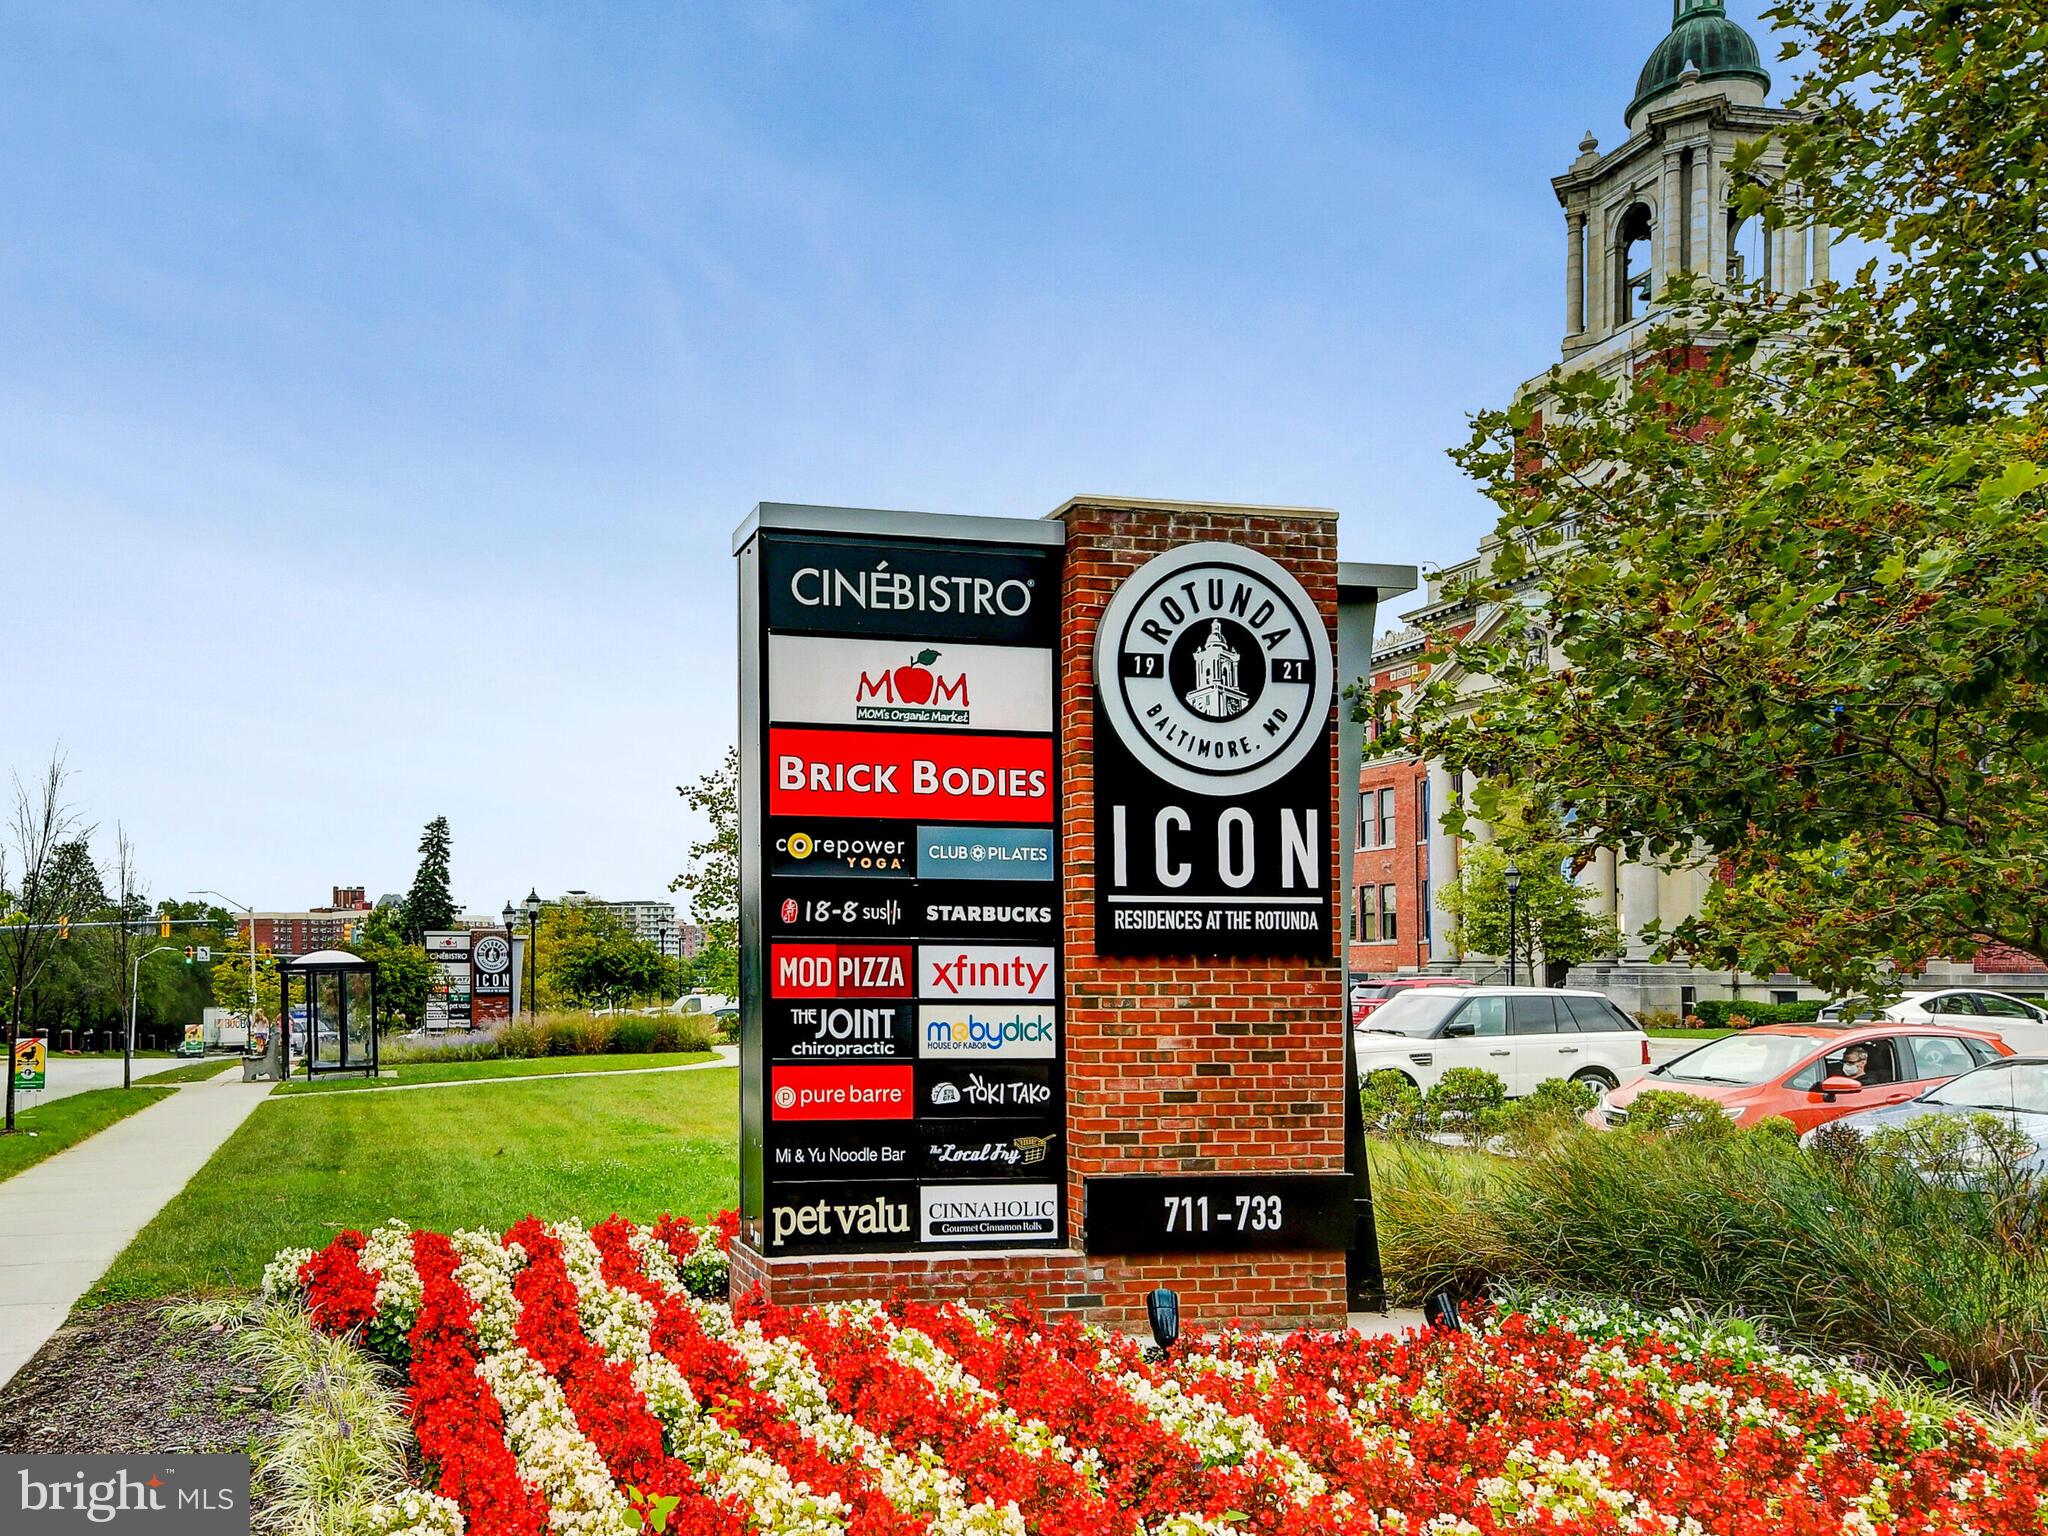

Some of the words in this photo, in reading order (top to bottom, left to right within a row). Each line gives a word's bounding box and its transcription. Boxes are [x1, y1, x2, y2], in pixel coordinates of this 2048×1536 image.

[1141, 578, 1292, 651] ROTUNDA
[1134, 656, 1155, 675] 19
[1283, 662, 1303, 680] 21
[857, 708, 890, 720] MOM's
[891, 710, 930, 723] Organic
[931, 711, 969, 723] Market
[1263, 708, 1288, 737] MD
[775, 832, 905, 859] corepower
[928, 845, 968, 859] CLUB
[988, 847, 1048, 861] PILATES
[1112, 805, 1320, 889] ICON
[847, 857, 902, 869] YOGA
[805, 900, 859, 923] 18-8
[926, 905, 1052, 923] STARBUCKS
[1114, 910, 1202, 930] RESIDENCES
[1205, 910, 1222, 930] AT
[1225, 911, 1251, 930] THE
[1255, 911, 1319, 930] ROTUNDA
[476, 974, 509, 987] ICON
[780, 957, 831, 987] MOD
[838, 957, 905, 987] PIZZA
[932, 954, 1049, 994] xfinity
[790, 1008, 817, 1025] THE
[815, 1008, 896, 1039] JOINT
[927, 1013, 1053, 1050] mobydick
[791, 1041, 895, 1057] chiropractic
[927, 1042, 952, 1050] HOUSE
[962, 1041, 987, 1049] KABOB
[800, 1088, 845, 1108] pure
[849, 1084, 902, 1103] barre
[962, 1072, 1004, 1104] TOKI
[1007, 1082, 1051, 1104] TAKO
[775, 1148, 792, 1163] Mi
[794, 1148, 805, 1163] &
[807, 1147, 826, 1162] Yu
[829, 1147, 878, 1162] Noodle
[881, 1146, 906, 1161] Bar
[929, 1144, 943, 1154] The
[938, 1143, 992, 1162] Local
[989, 1143, 1021, 1164] Fry
[772, 1199, 832, 1246] pet
[833, 1196, 911, 1234] valu
[929, 1201, 1055, 1219] CINNAHOLIC
[942, 1223, 979, 1233] Gourmet
[979, 1222, 1021, 1232] Cinnamon
[1022, 1221, 1043, 1231] Rolls
